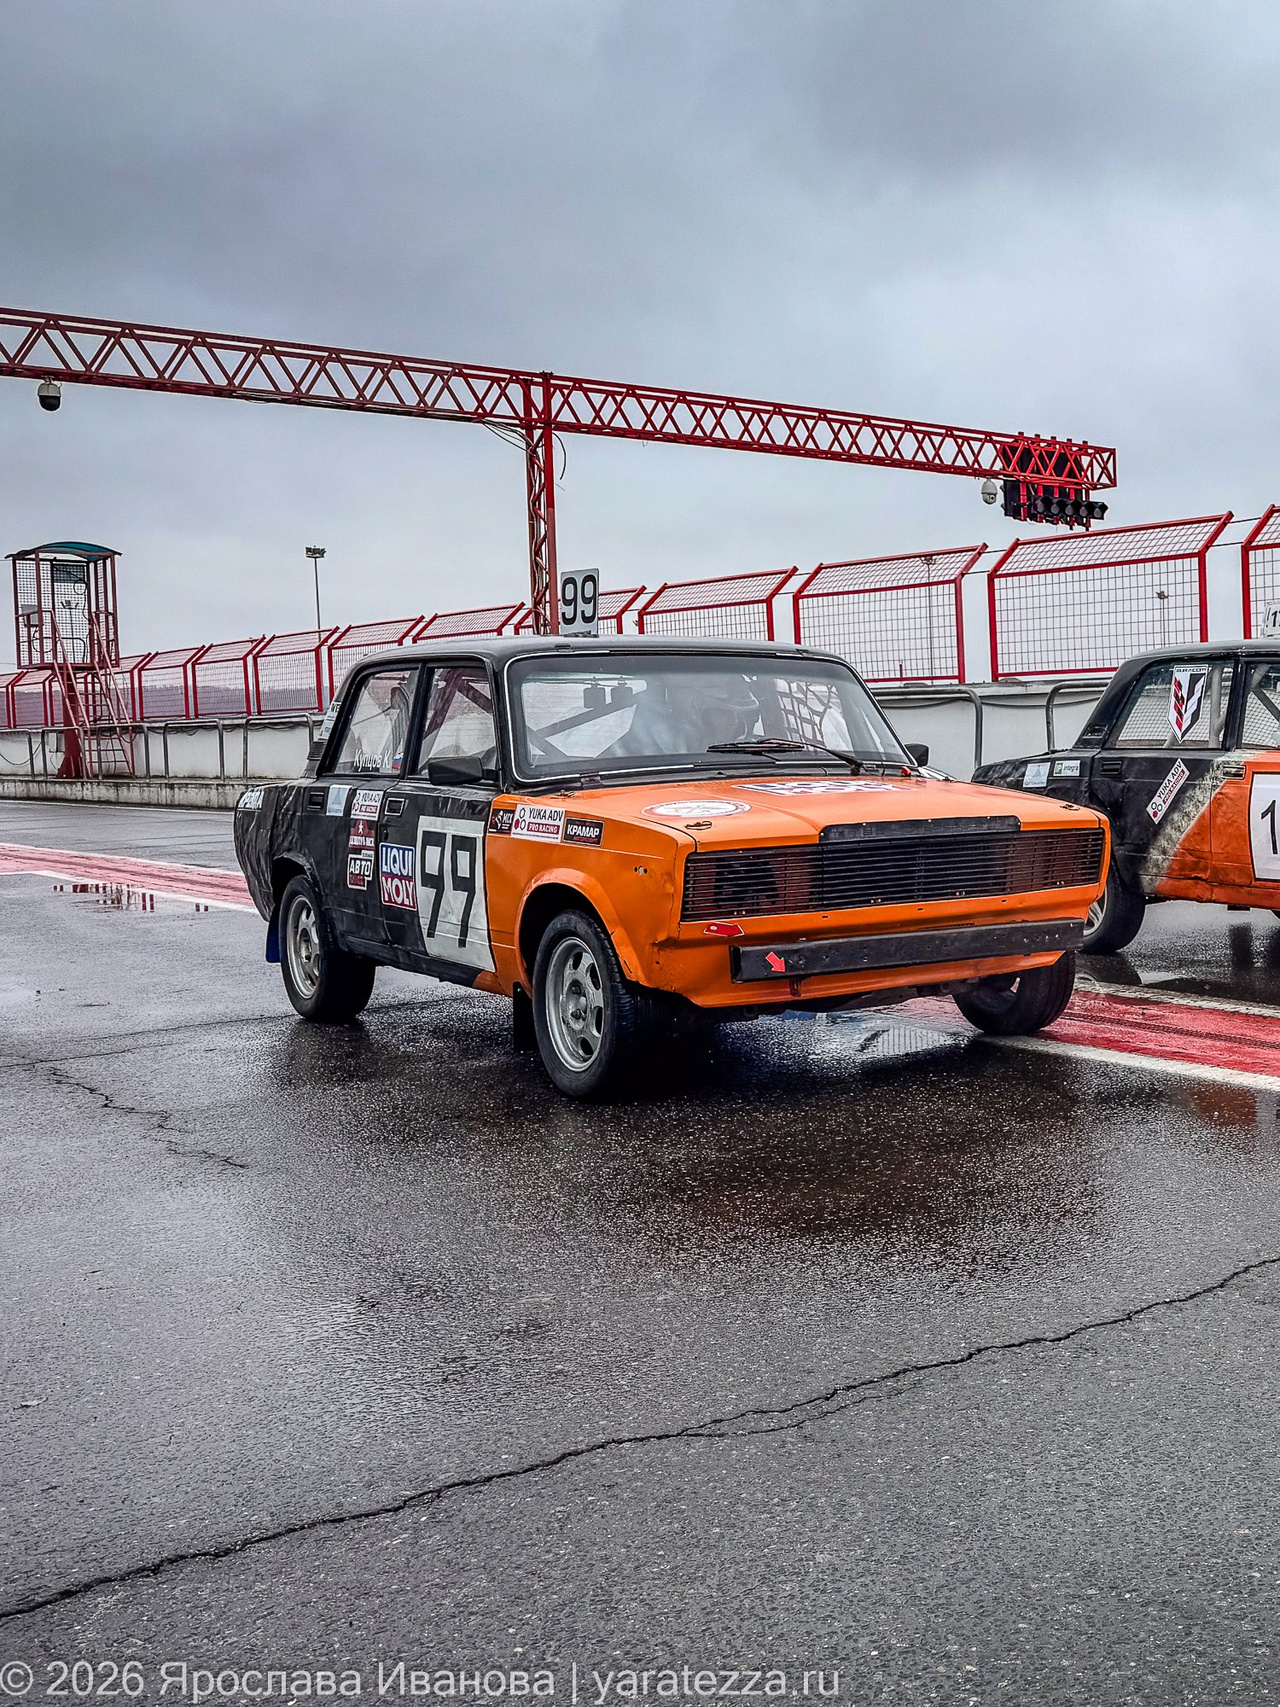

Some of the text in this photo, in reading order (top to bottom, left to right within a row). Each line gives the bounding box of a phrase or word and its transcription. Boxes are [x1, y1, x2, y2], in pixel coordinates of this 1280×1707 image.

[561, 574, 597, 626] 99
[353, 749, 383, 772] Купцов
[1157, 761, 1182, 800] YUKA ADV
[528, 807, 563, 822] YUKA ADV
[529, 823, 558, 834] PRO RACING
[567, 824, 600, 838] КРАМАР
[350, 859, 371, 876] АВТО
[382, 847, 413, 877] LIQUI
[382, 876, 415, 906] MOLY
[420, 830, 477, 948] 99
